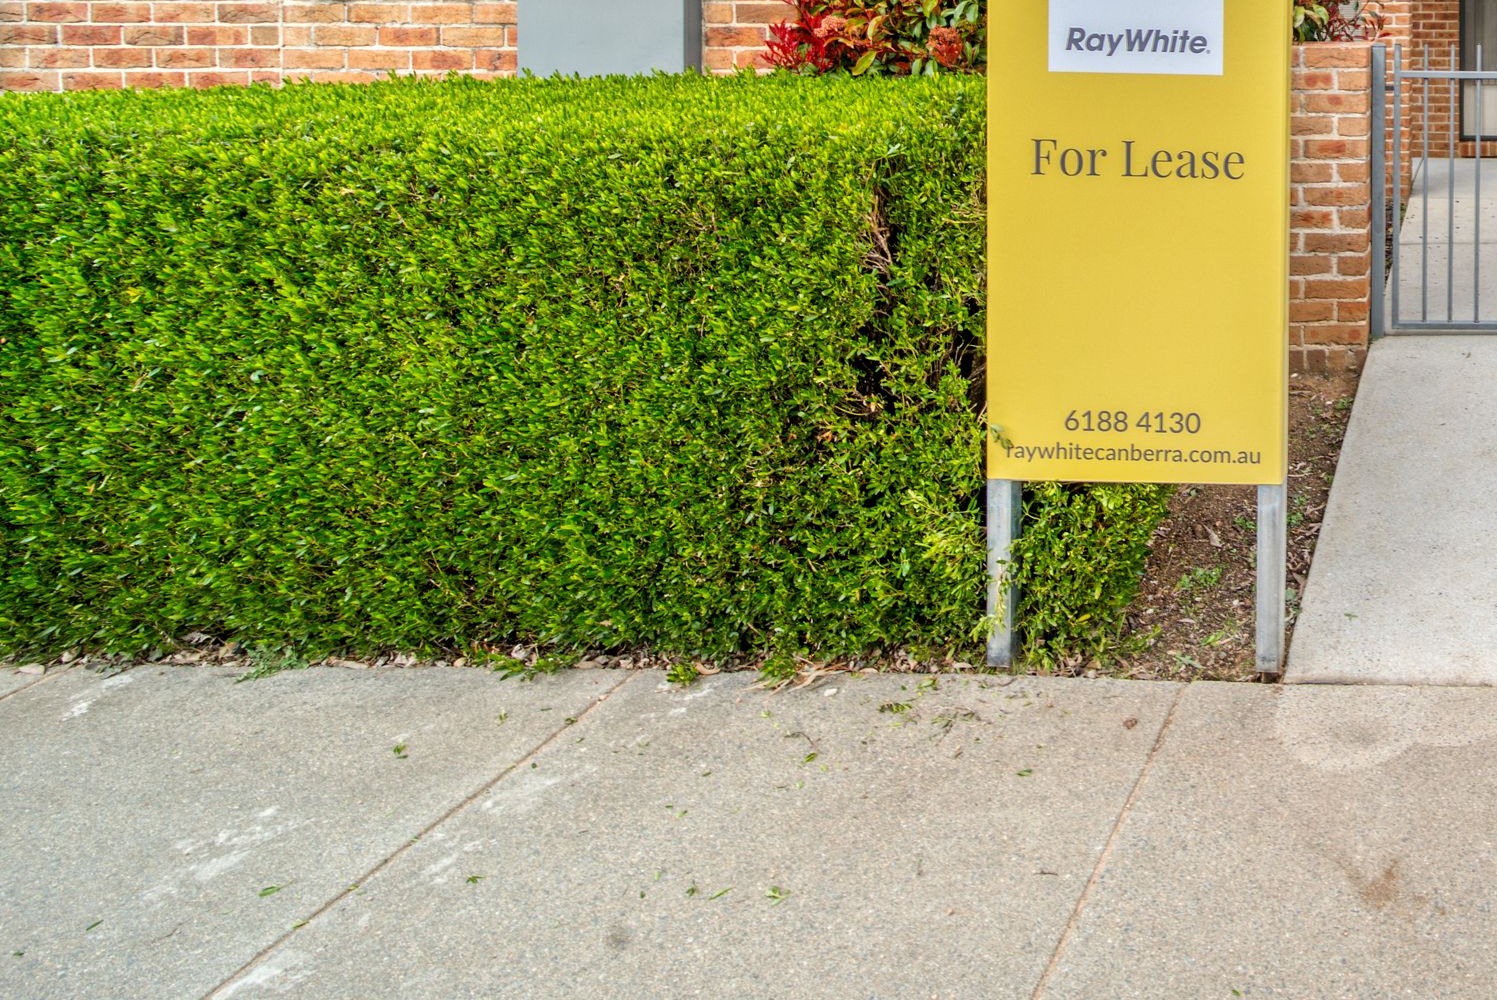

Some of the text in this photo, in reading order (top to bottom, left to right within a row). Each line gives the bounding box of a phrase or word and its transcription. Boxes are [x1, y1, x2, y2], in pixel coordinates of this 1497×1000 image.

[1030, 138, 1245, 180] For Lease
[1064, 409, 1201, 434] 6188 4130
[1006, 441, 1261, 465] raywhitecanberra.com.au
